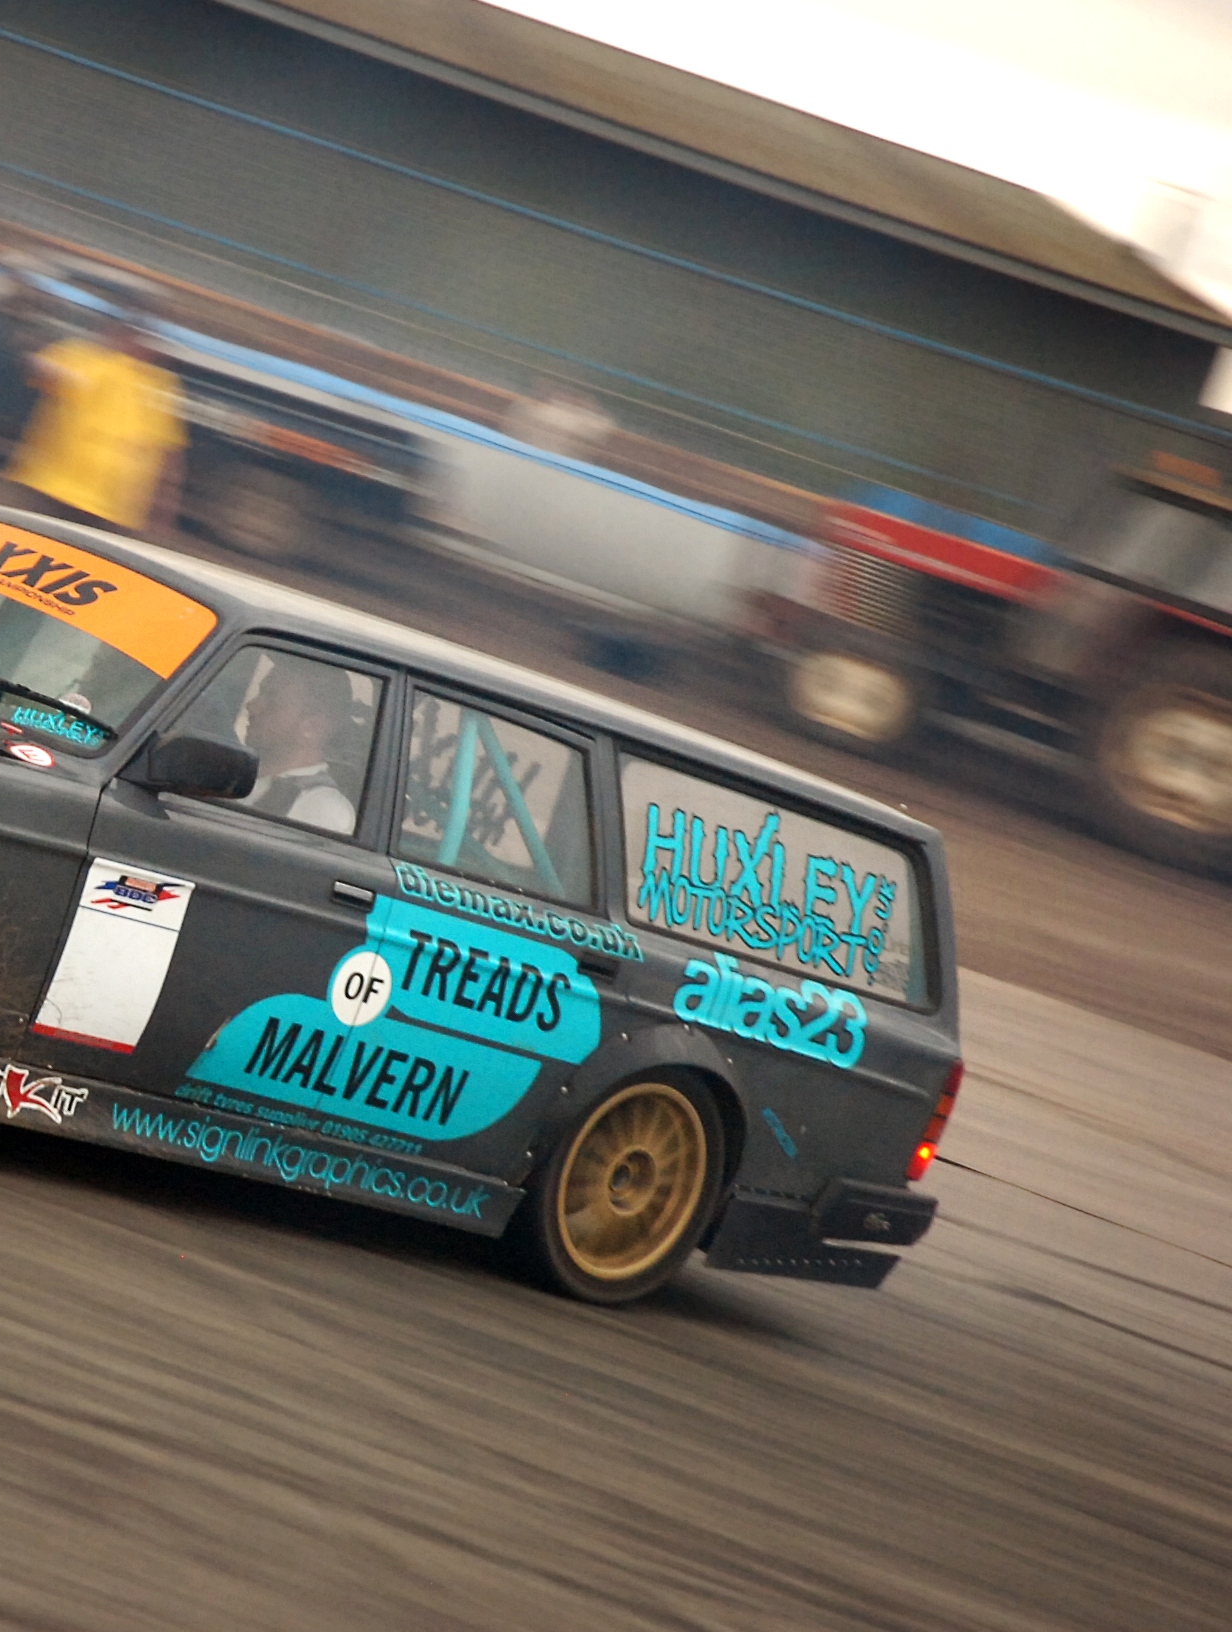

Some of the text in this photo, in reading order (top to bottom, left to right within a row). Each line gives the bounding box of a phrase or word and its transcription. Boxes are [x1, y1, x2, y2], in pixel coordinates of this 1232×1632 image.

[13, 705, 98, 744] HUXLEY
[637, 867, 868, 978] MOTORSPORT
[640, 803, 878, 935] HUXLEY
[344, 973, 384, 1004] OF
[401, 930, 571, 1032] TREADS
[673, 951, 868, 1070] alias23
[244, 1017, 470, 1126] MALVERN
[112, 1102, 491, 1219] www.signlinkgraphics.co.uk
